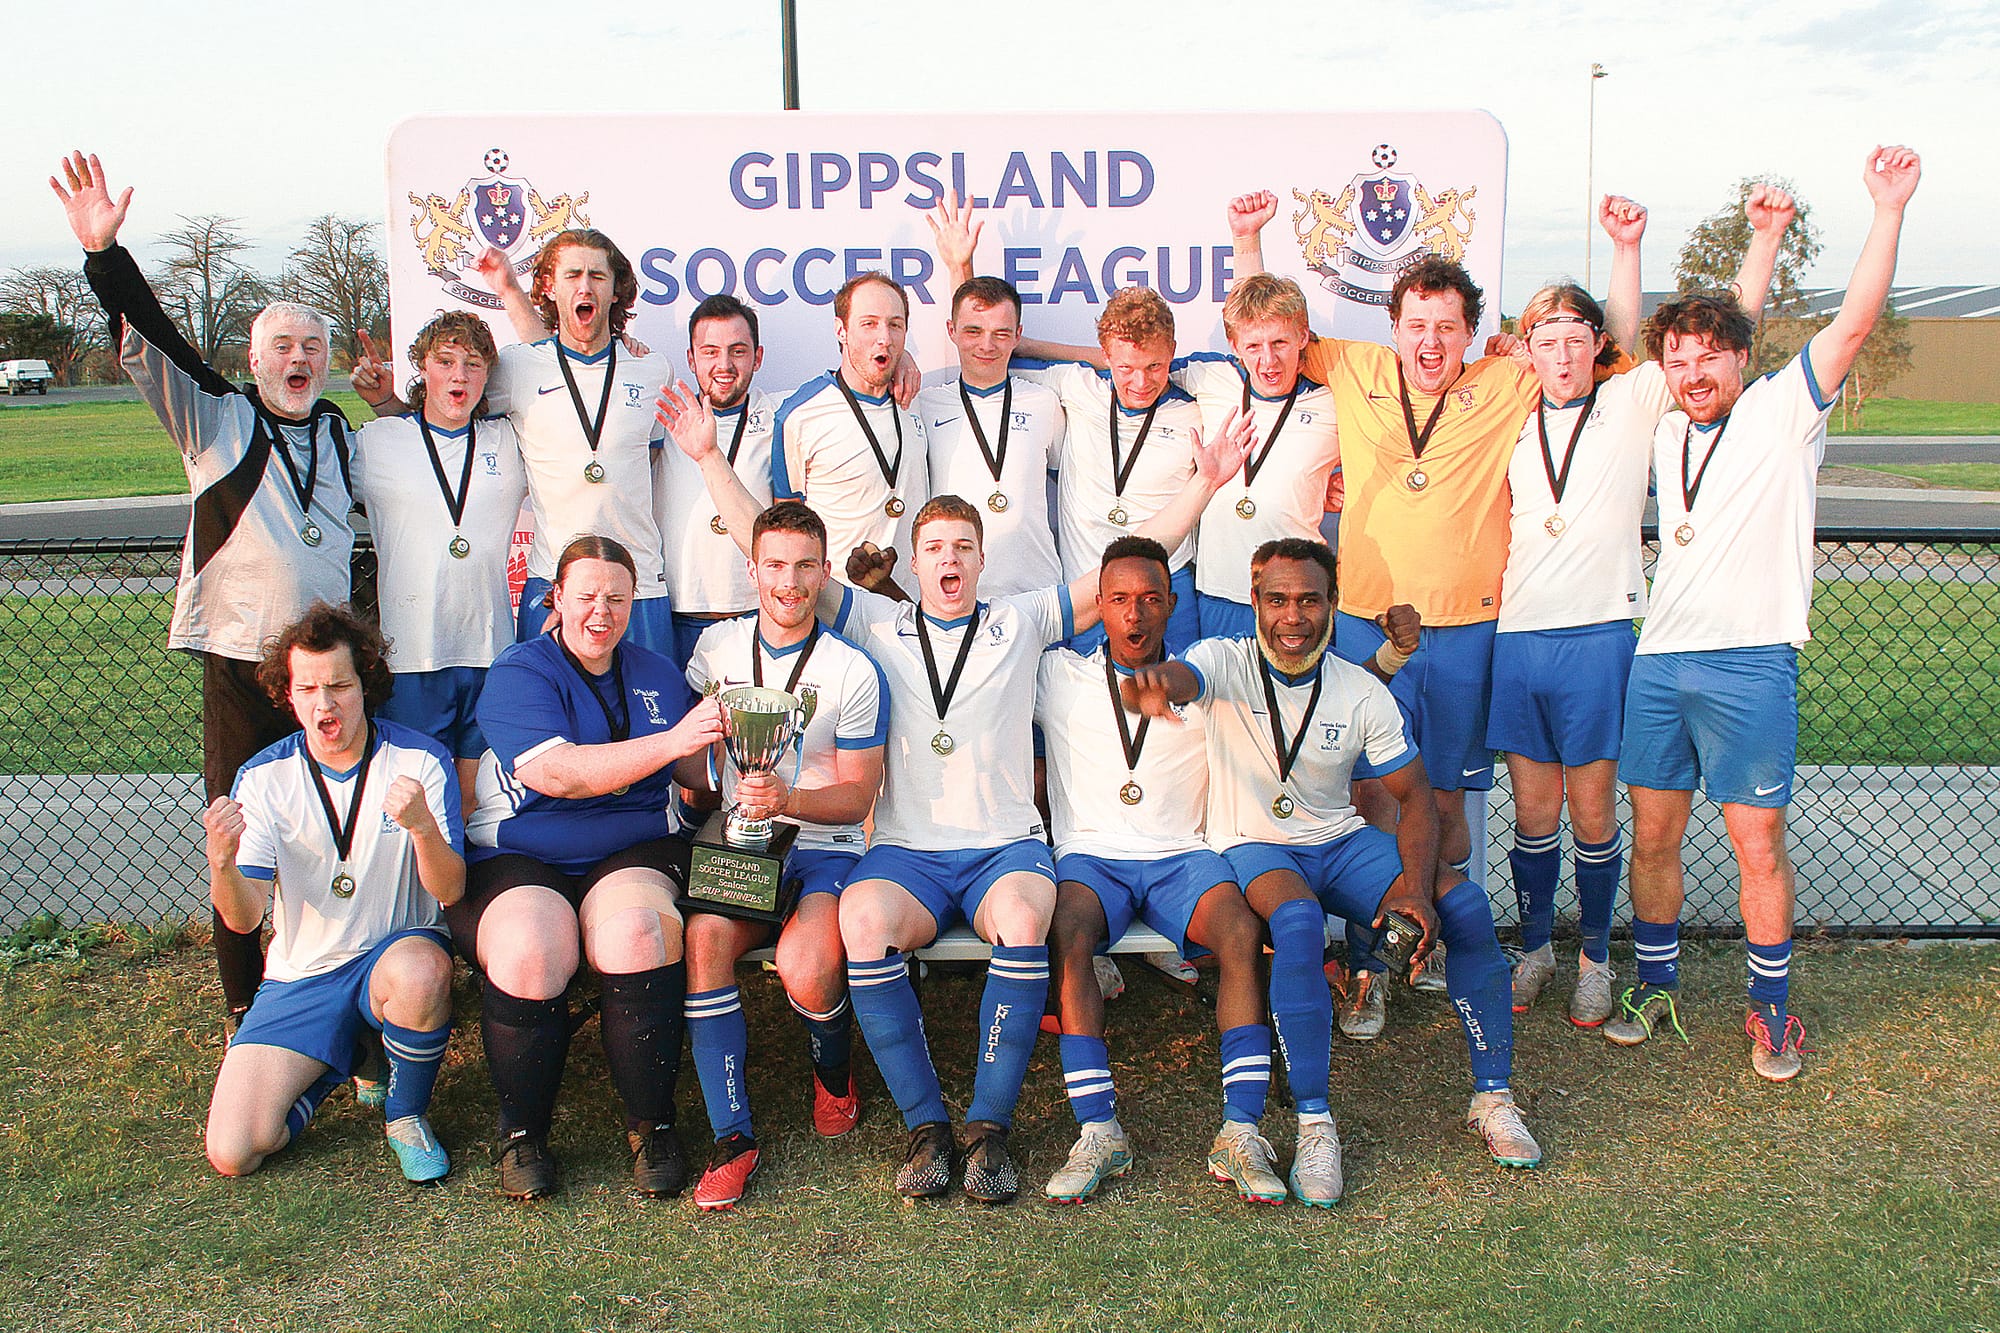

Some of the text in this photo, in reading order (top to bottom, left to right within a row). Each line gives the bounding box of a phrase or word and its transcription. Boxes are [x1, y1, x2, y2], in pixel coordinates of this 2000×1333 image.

[730, 150, 1155, 209] GIPPSLAND
[1349, 252, 1423, 273] GIPPSLAND
[640, 246, 1234, 306] SOCCER EAGUE
[450, 284, 505, 308] SOCCER
[1329, 279, 1383, 304] SOCCER
[698, 864, 770, 884] SOCCER LEAGUE
[710, 856, 760, 872] GIPPSLAND
[702, 885, 720, 896] CUP
[722, 889, 763, 904] WINNERS
[718, 878, 748, 891] Seniors
[984, 1003, 1013, 1063] KNIGHTS
[1455, 997, 1488, 1051] KNIGHTS
[724, 1054, 741, 1112] KNIGHTS
